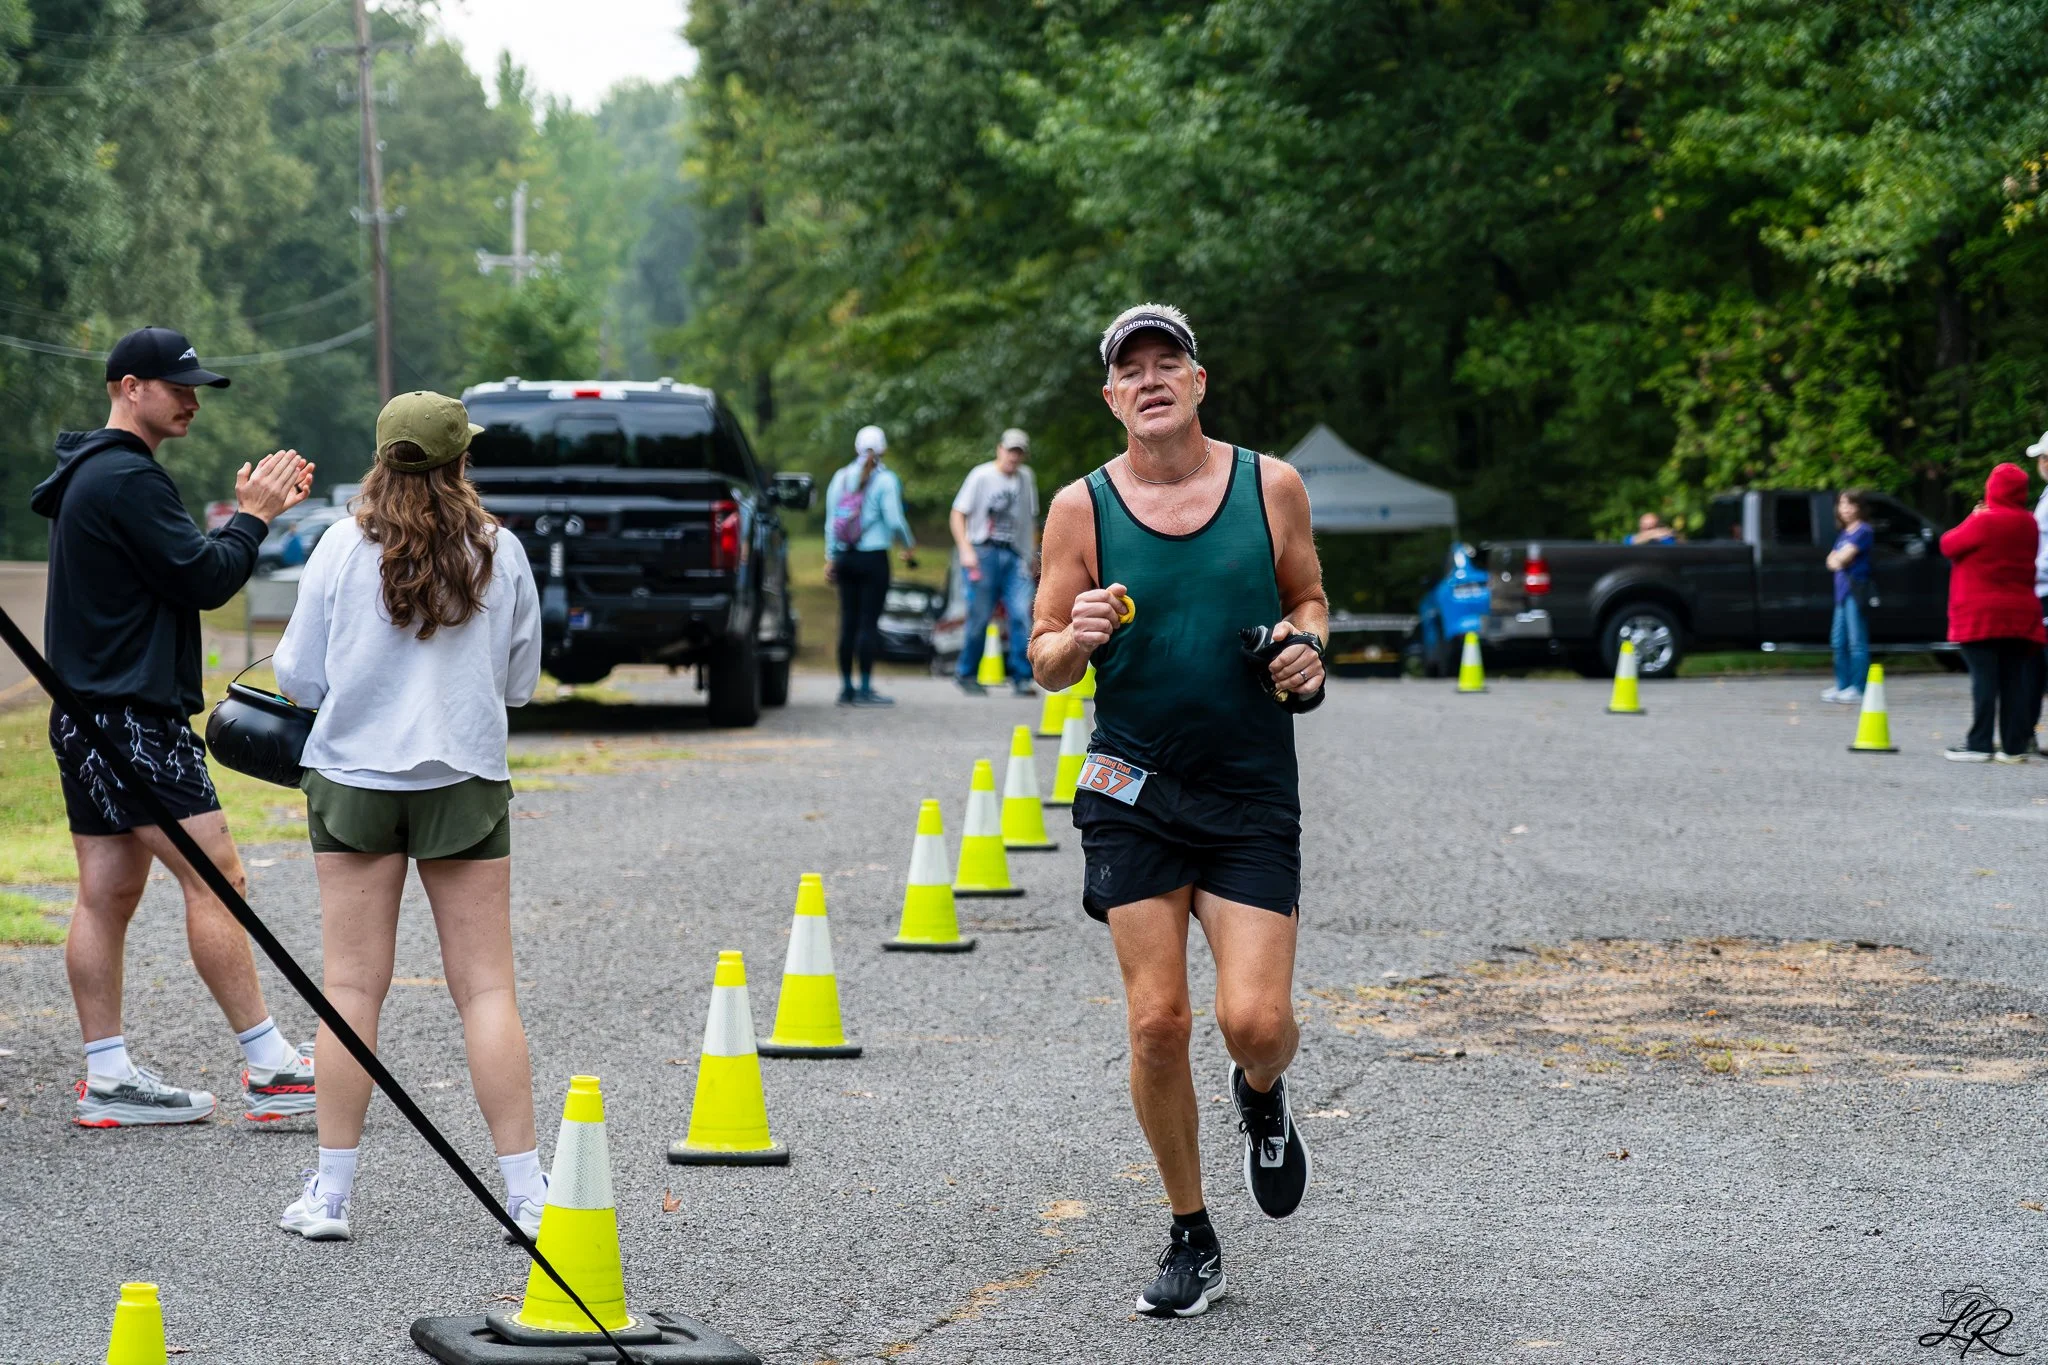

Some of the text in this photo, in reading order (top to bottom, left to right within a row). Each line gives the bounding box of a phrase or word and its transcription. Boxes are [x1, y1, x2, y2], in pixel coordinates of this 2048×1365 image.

[1123, 320, 1177, 333] RAGNAR TRAIL
[1095, 756, 1131, 775] Viking Dad
[1081, 764, 1134, 795] 157
